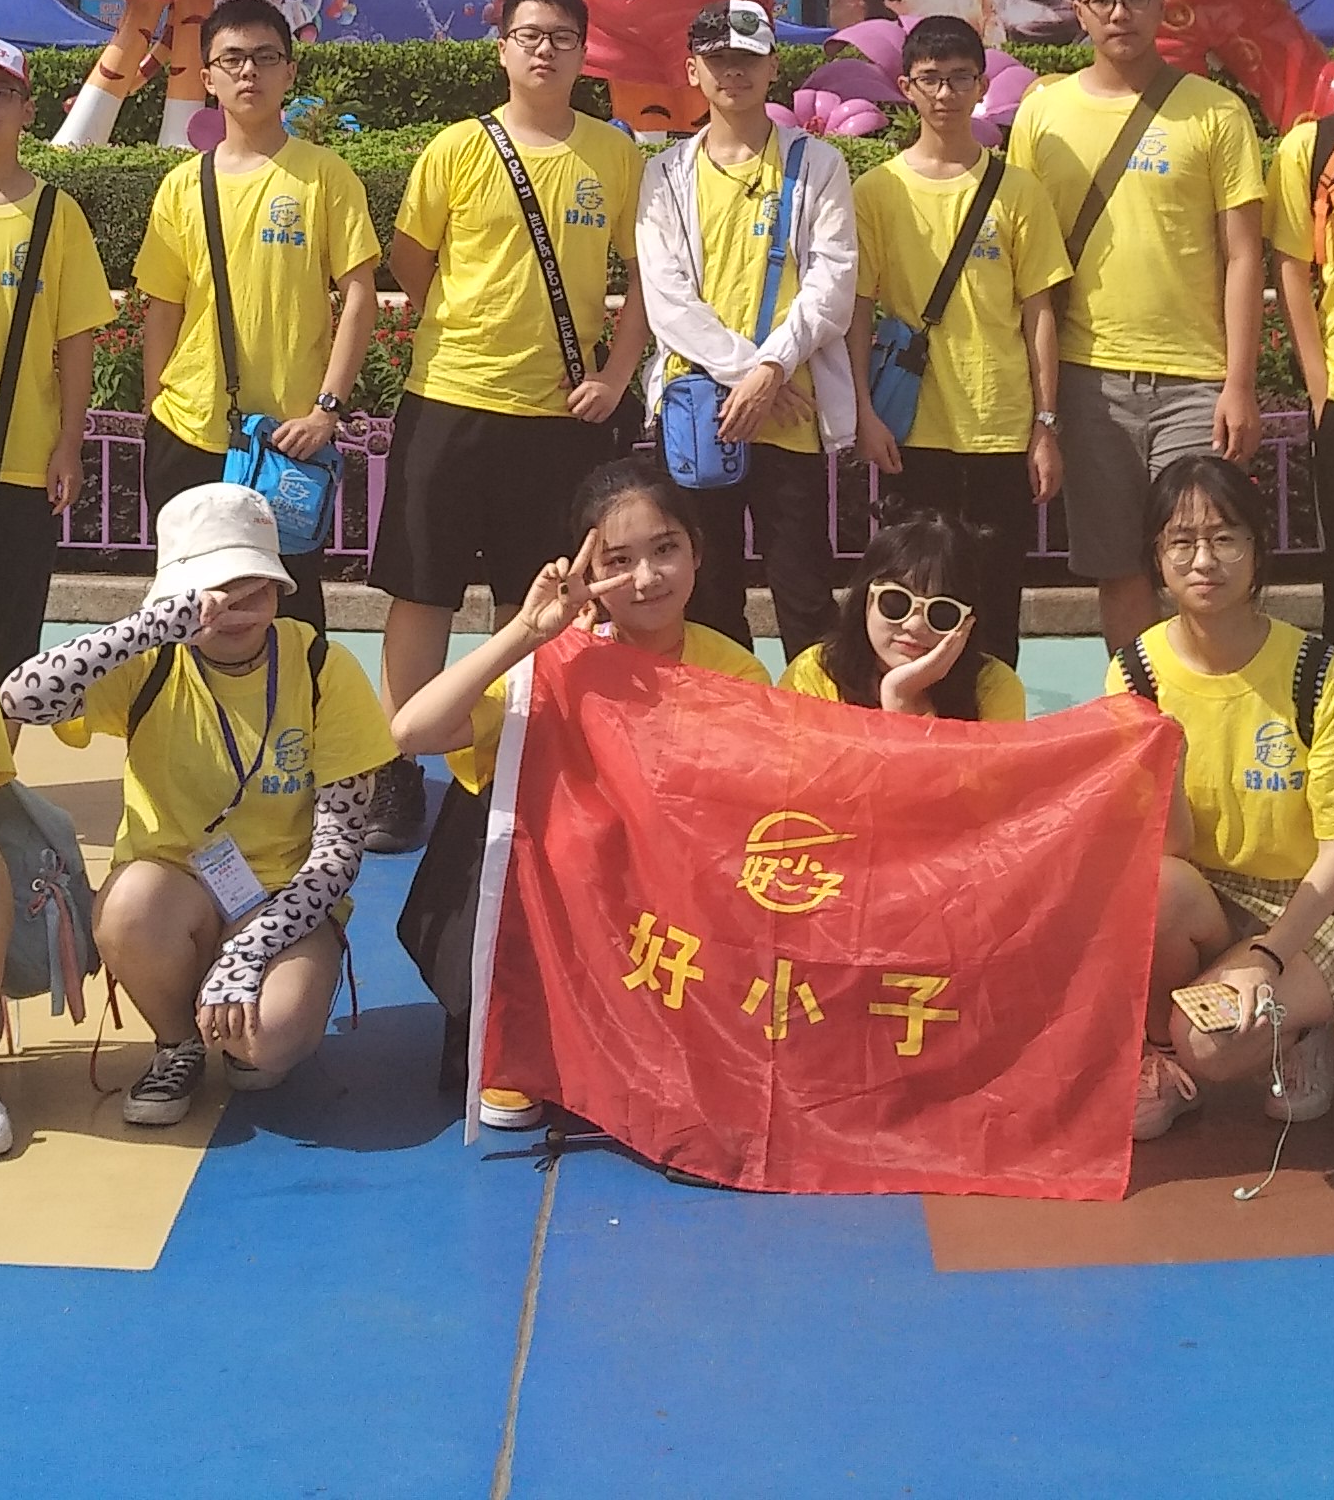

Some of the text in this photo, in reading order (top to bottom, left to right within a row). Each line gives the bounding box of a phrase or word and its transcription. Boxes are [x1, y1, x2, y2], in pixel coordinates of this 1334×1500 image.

[736, 854, 844, 896] 好小子
[622, 912, 959, 1056] 好小子
